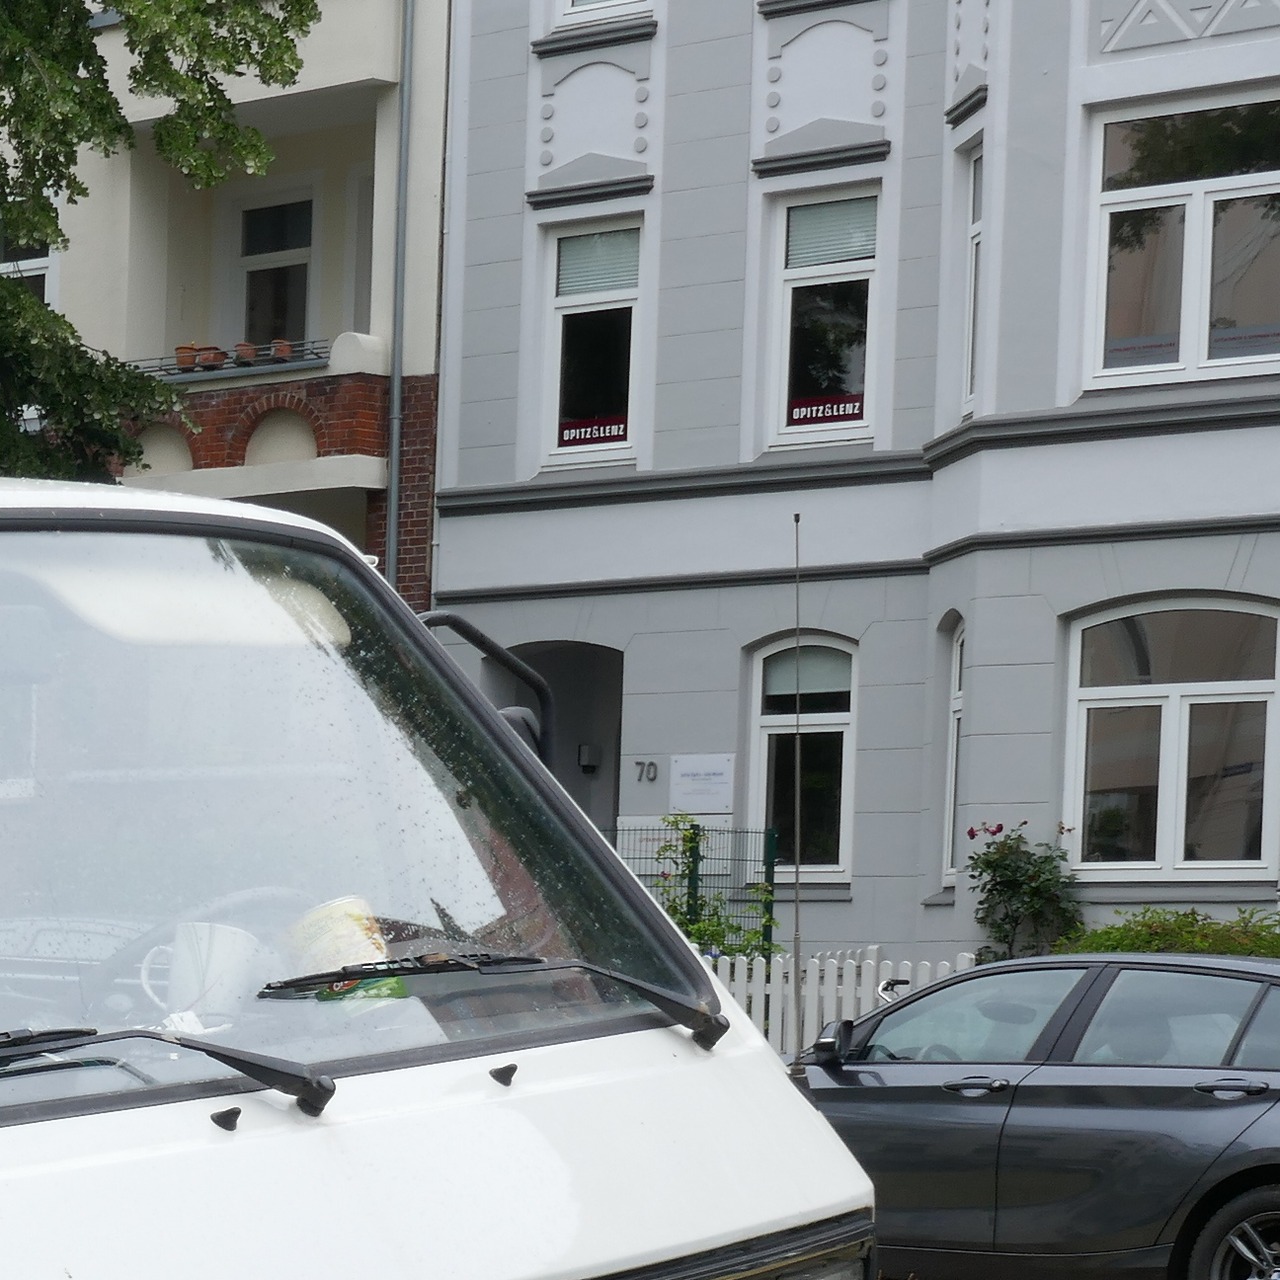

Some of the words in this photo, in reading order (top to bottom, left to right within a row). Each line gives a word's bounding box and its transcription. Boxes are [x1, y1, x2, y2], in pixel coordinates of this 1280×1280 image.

[792, 402, 860, 420] OPITZ&LENZ
[562, 424, 625, 441] OPITZ&LENZ
[634, 761, 658, 782] 70
